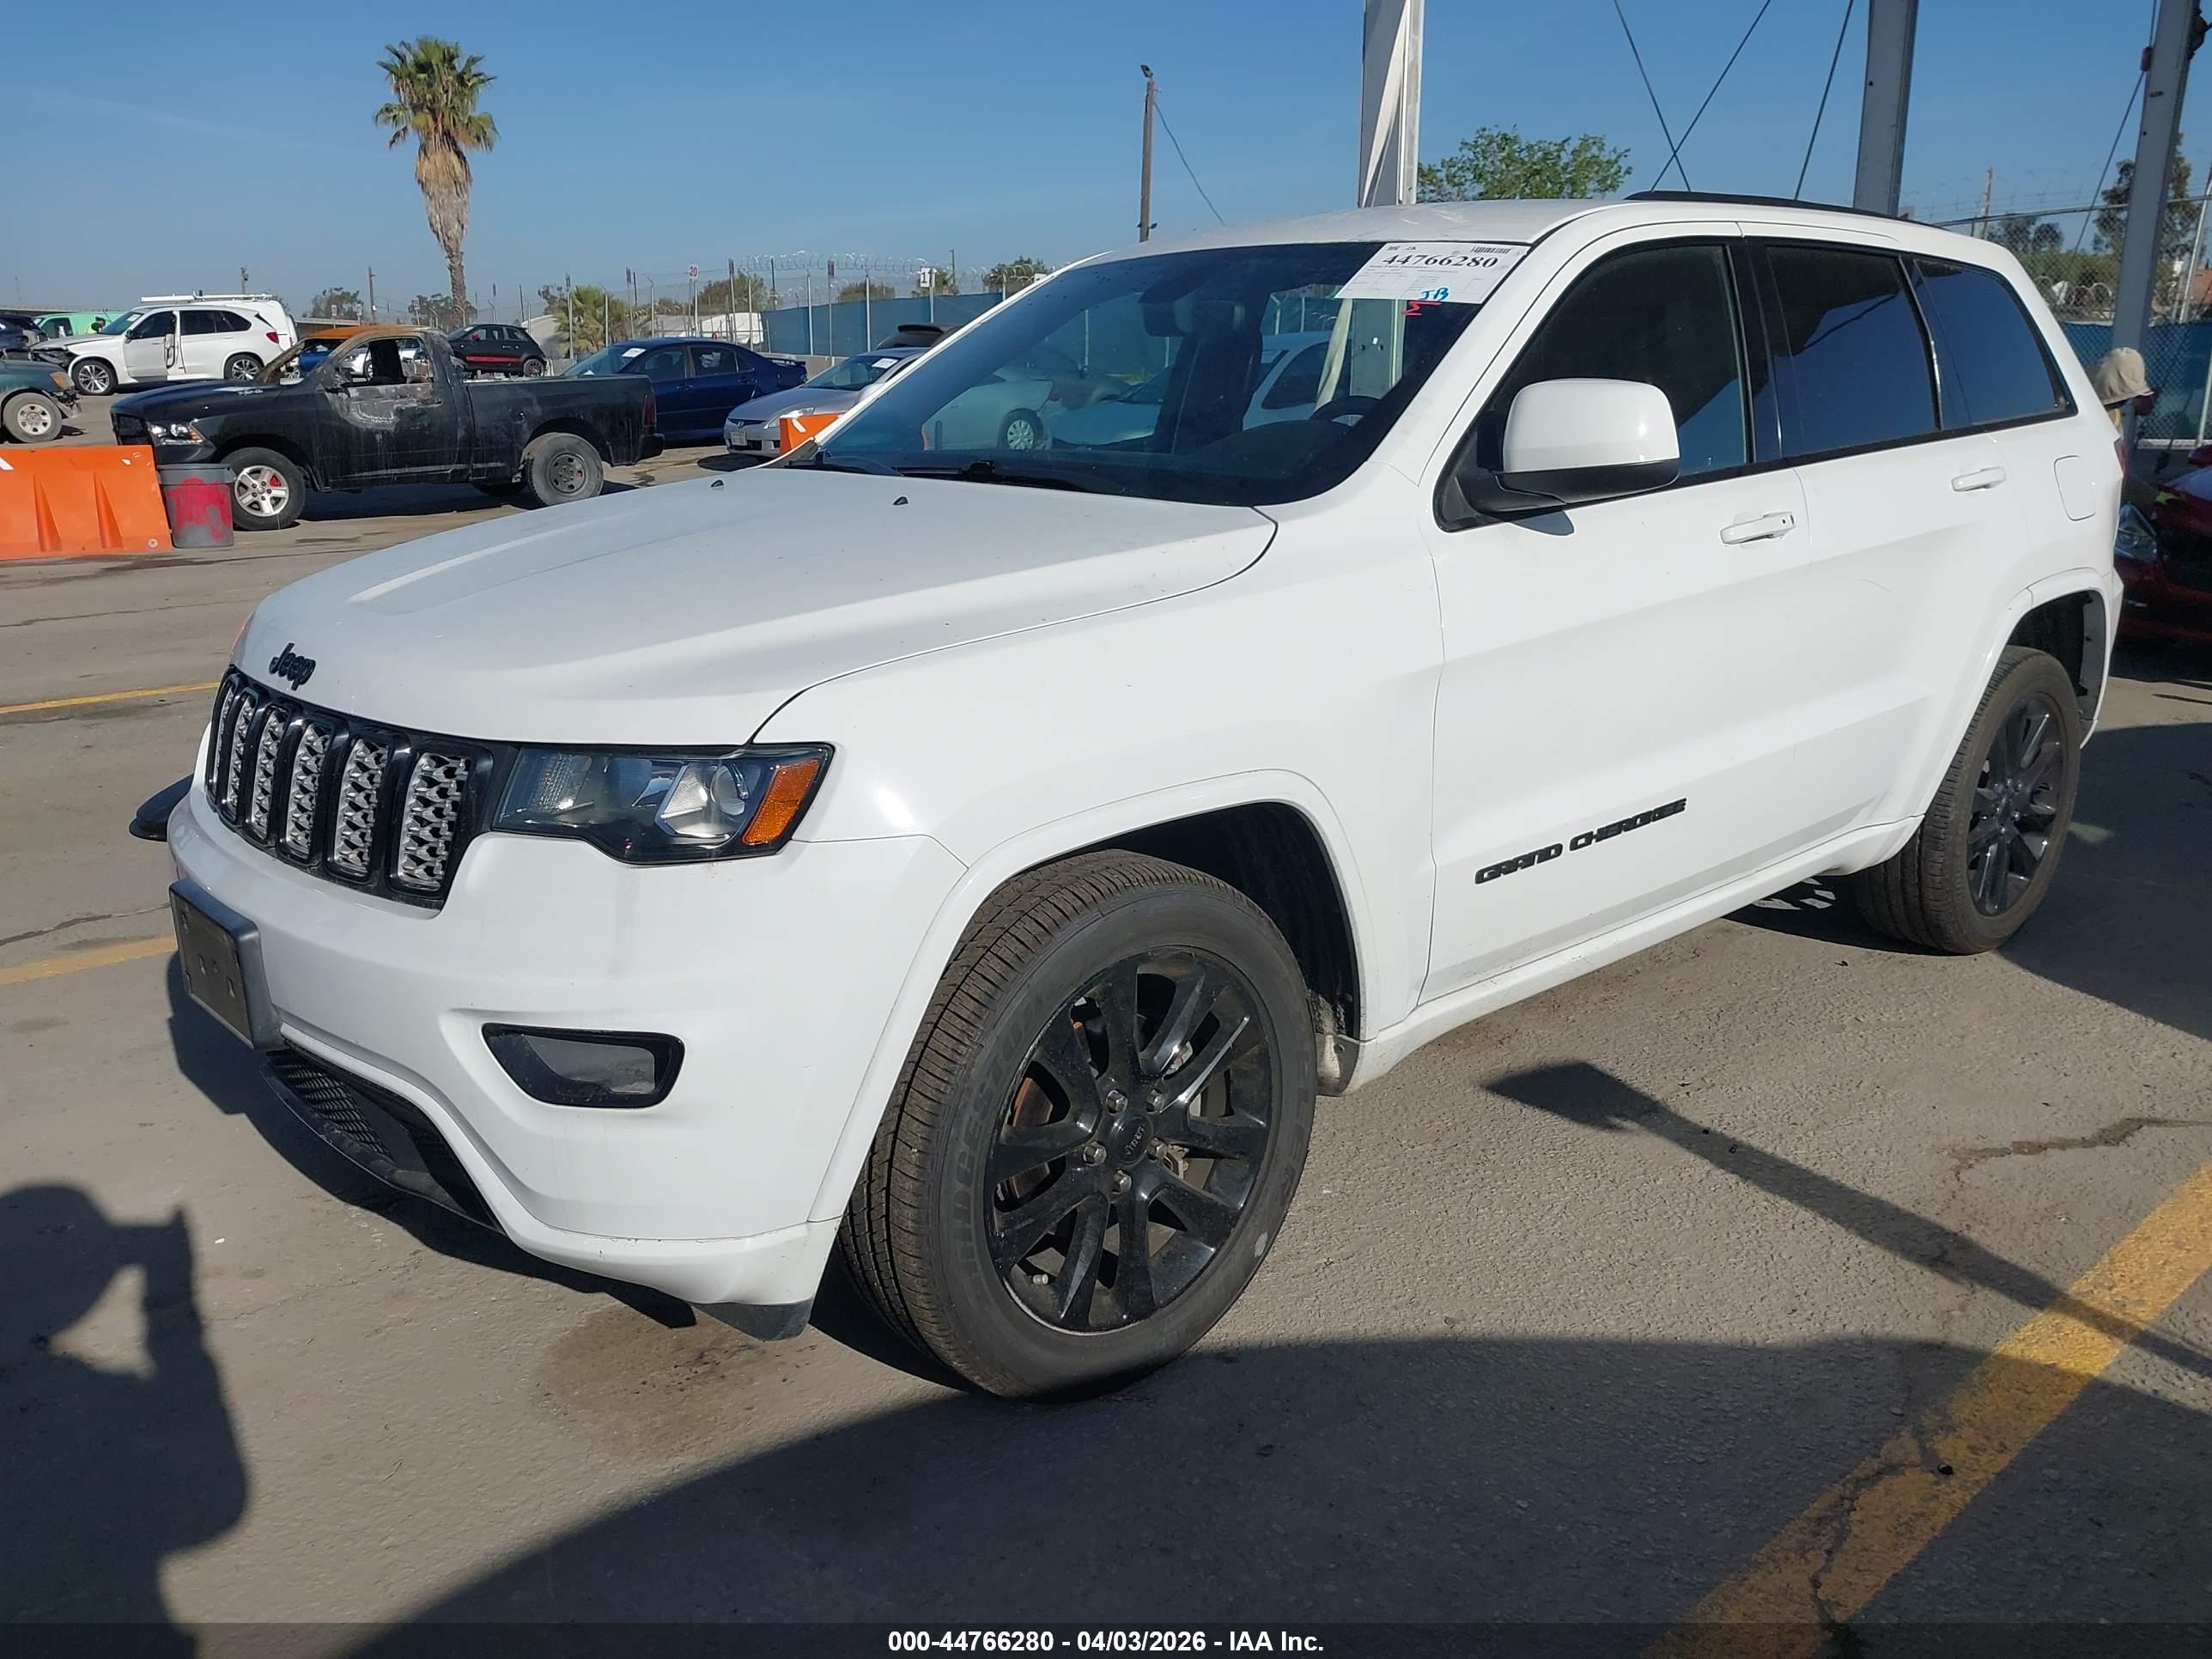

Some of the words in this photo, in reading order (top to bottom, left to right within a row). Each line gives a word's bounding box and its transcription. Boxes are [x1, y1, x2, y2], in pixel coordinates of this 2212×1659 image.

[690, 265, 698, 276] 20
[1382, 254, 1498, 268] 44766280
[269, 642, 316, 691] Jeep
[1474, 842, 1563, 884] GRAND
[1569, 797, 1687, 851] CHEROKEE
